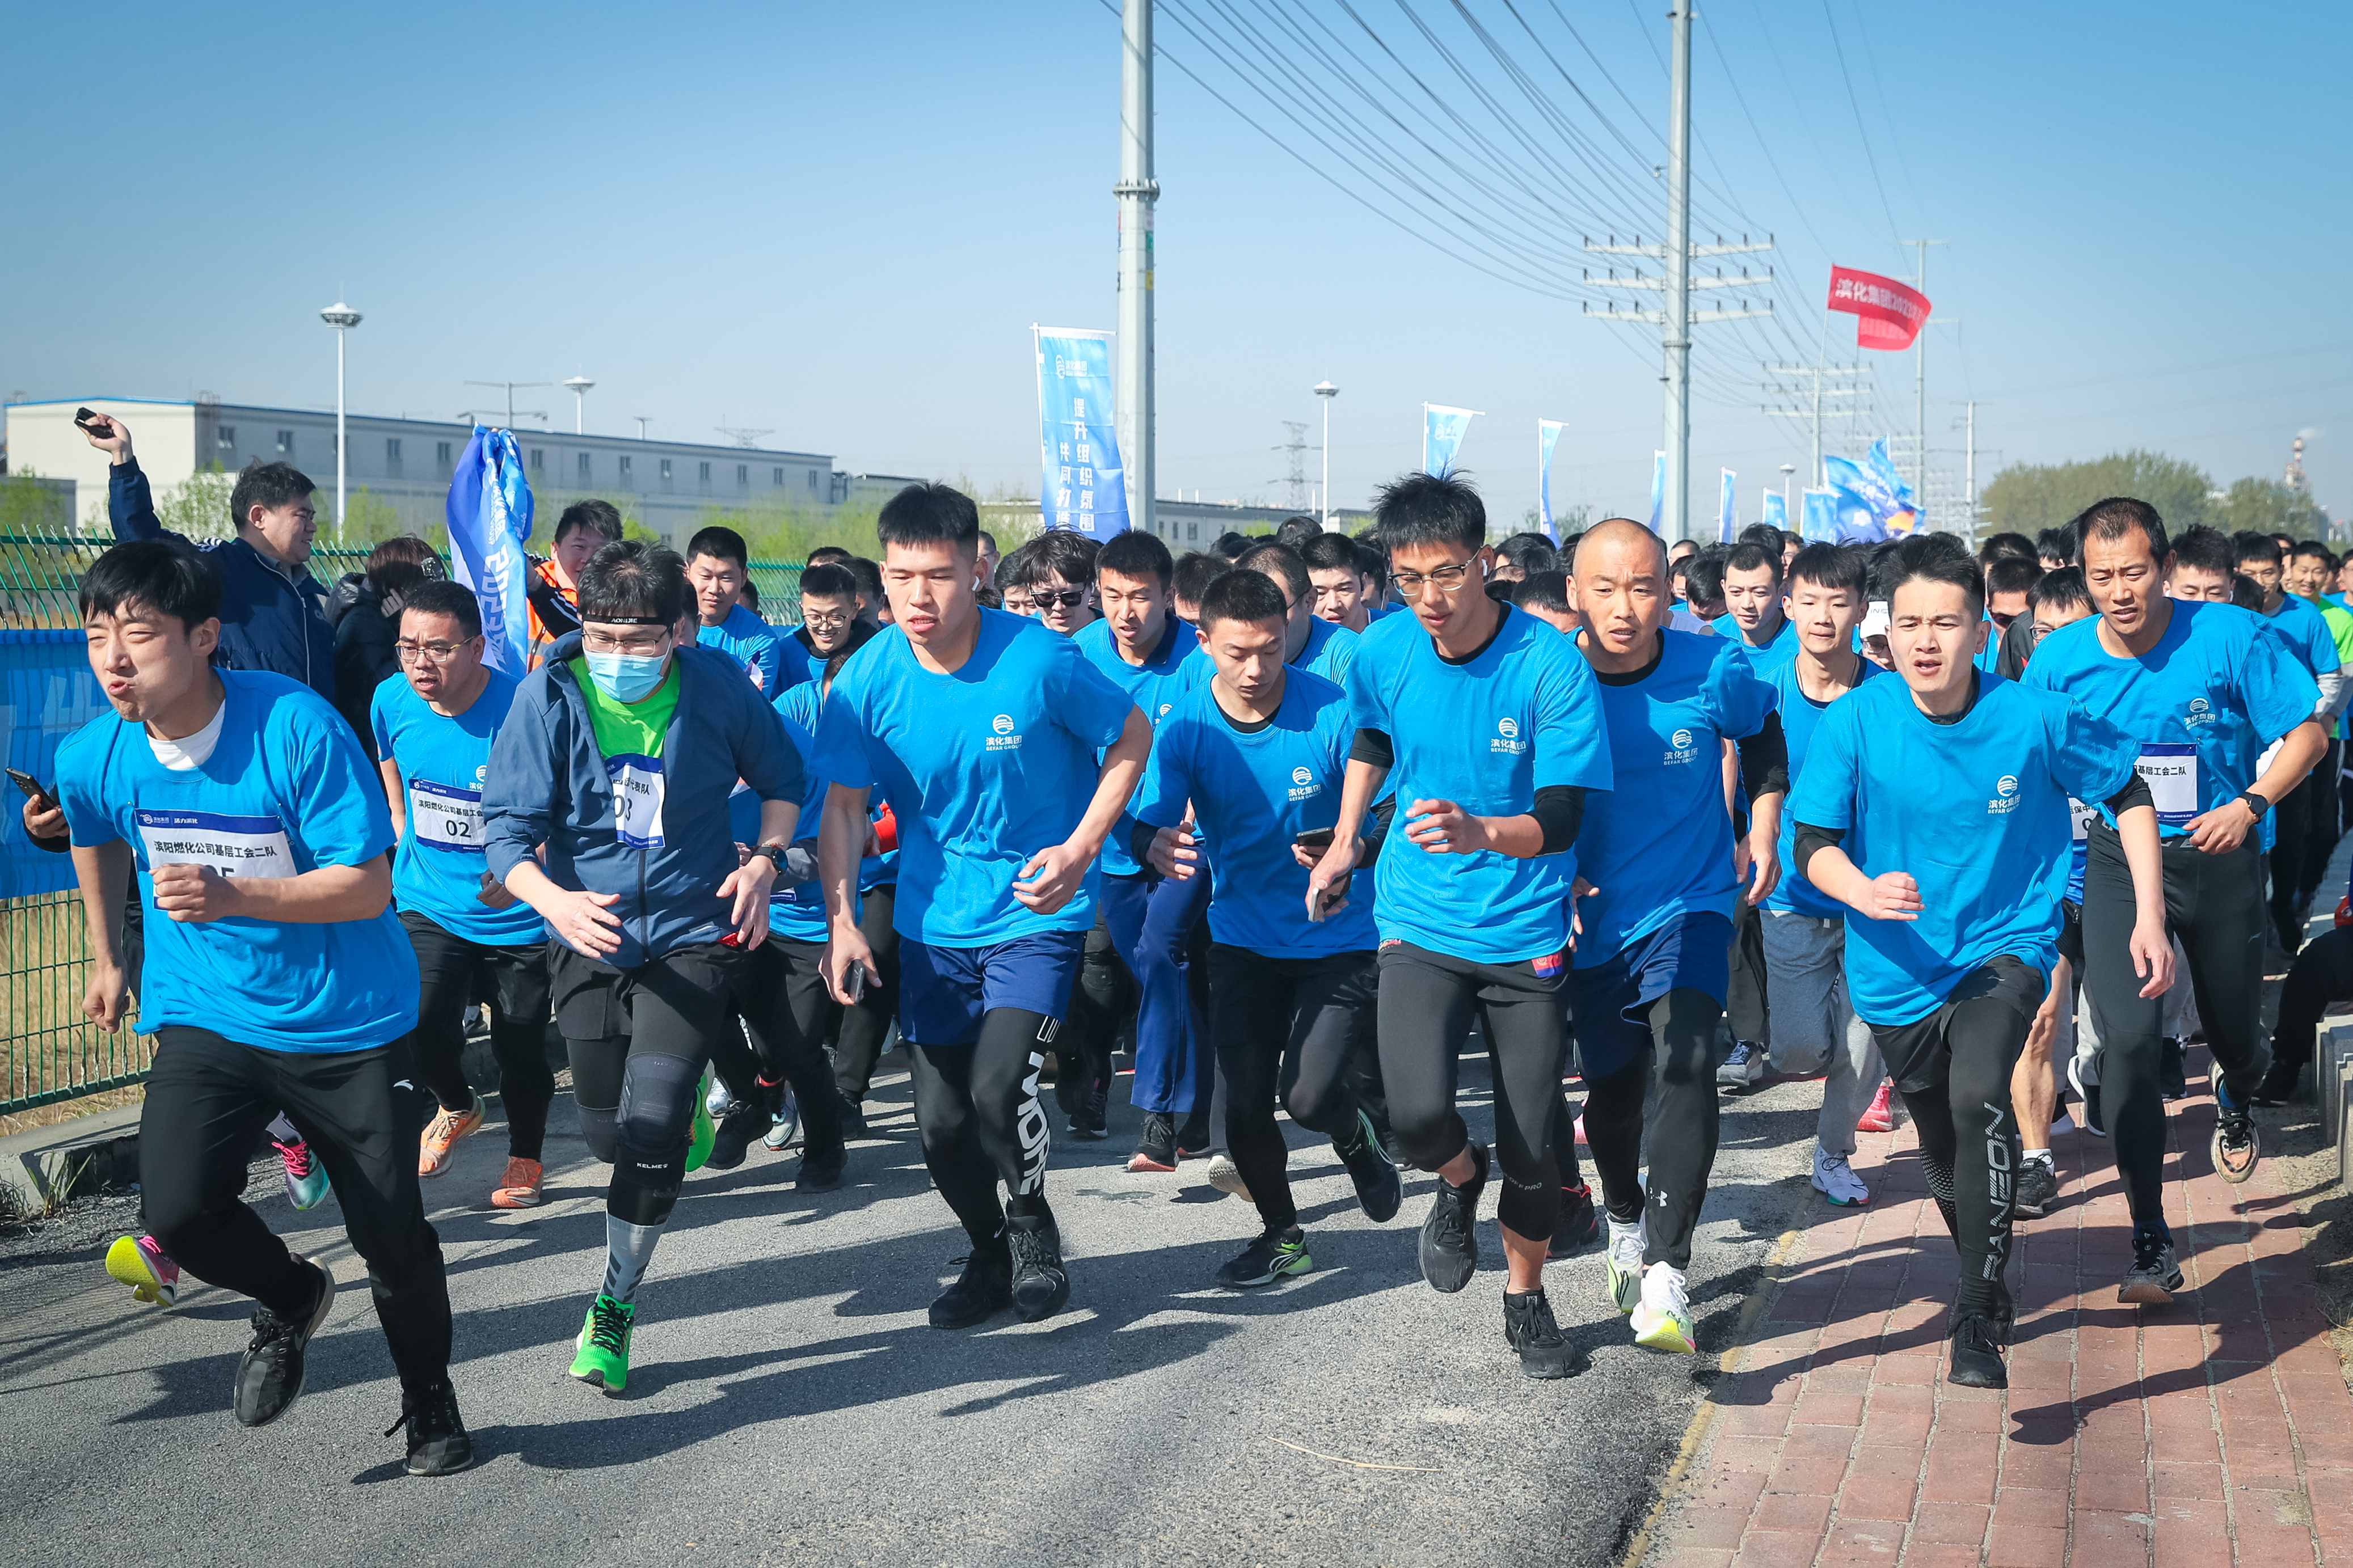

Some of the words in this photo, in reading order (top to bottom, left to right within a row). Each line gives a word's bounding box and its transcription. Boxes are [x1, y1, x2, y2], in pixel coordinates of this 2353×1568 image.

[1074, 398, 1095, 532] 提升组织氛围
[1056, 441, 1072, 530] 共同打造
[986, 735, 1022, 746] 滨化集团
[1490, 738, 1526, 750] 滨化集团
[1664, 747, 1698, 760] 滨化集团
[2134, 765, 2187, 776] 基层工会二队
[1288, 784, 1321, 797] 滨化集团
[418, 799, 484, 817] 滨阳燃化公司基层工会
[1988, 794, 2021, 809] 滨化集团
[446, 820, 471, 838] 02
[154, 840, 277, 859] 滨阳燃化公司基层工会二队
[1018, 1051, 1050, 1194] MORE
[1983, 1101, 2012, 1282] RANEON
